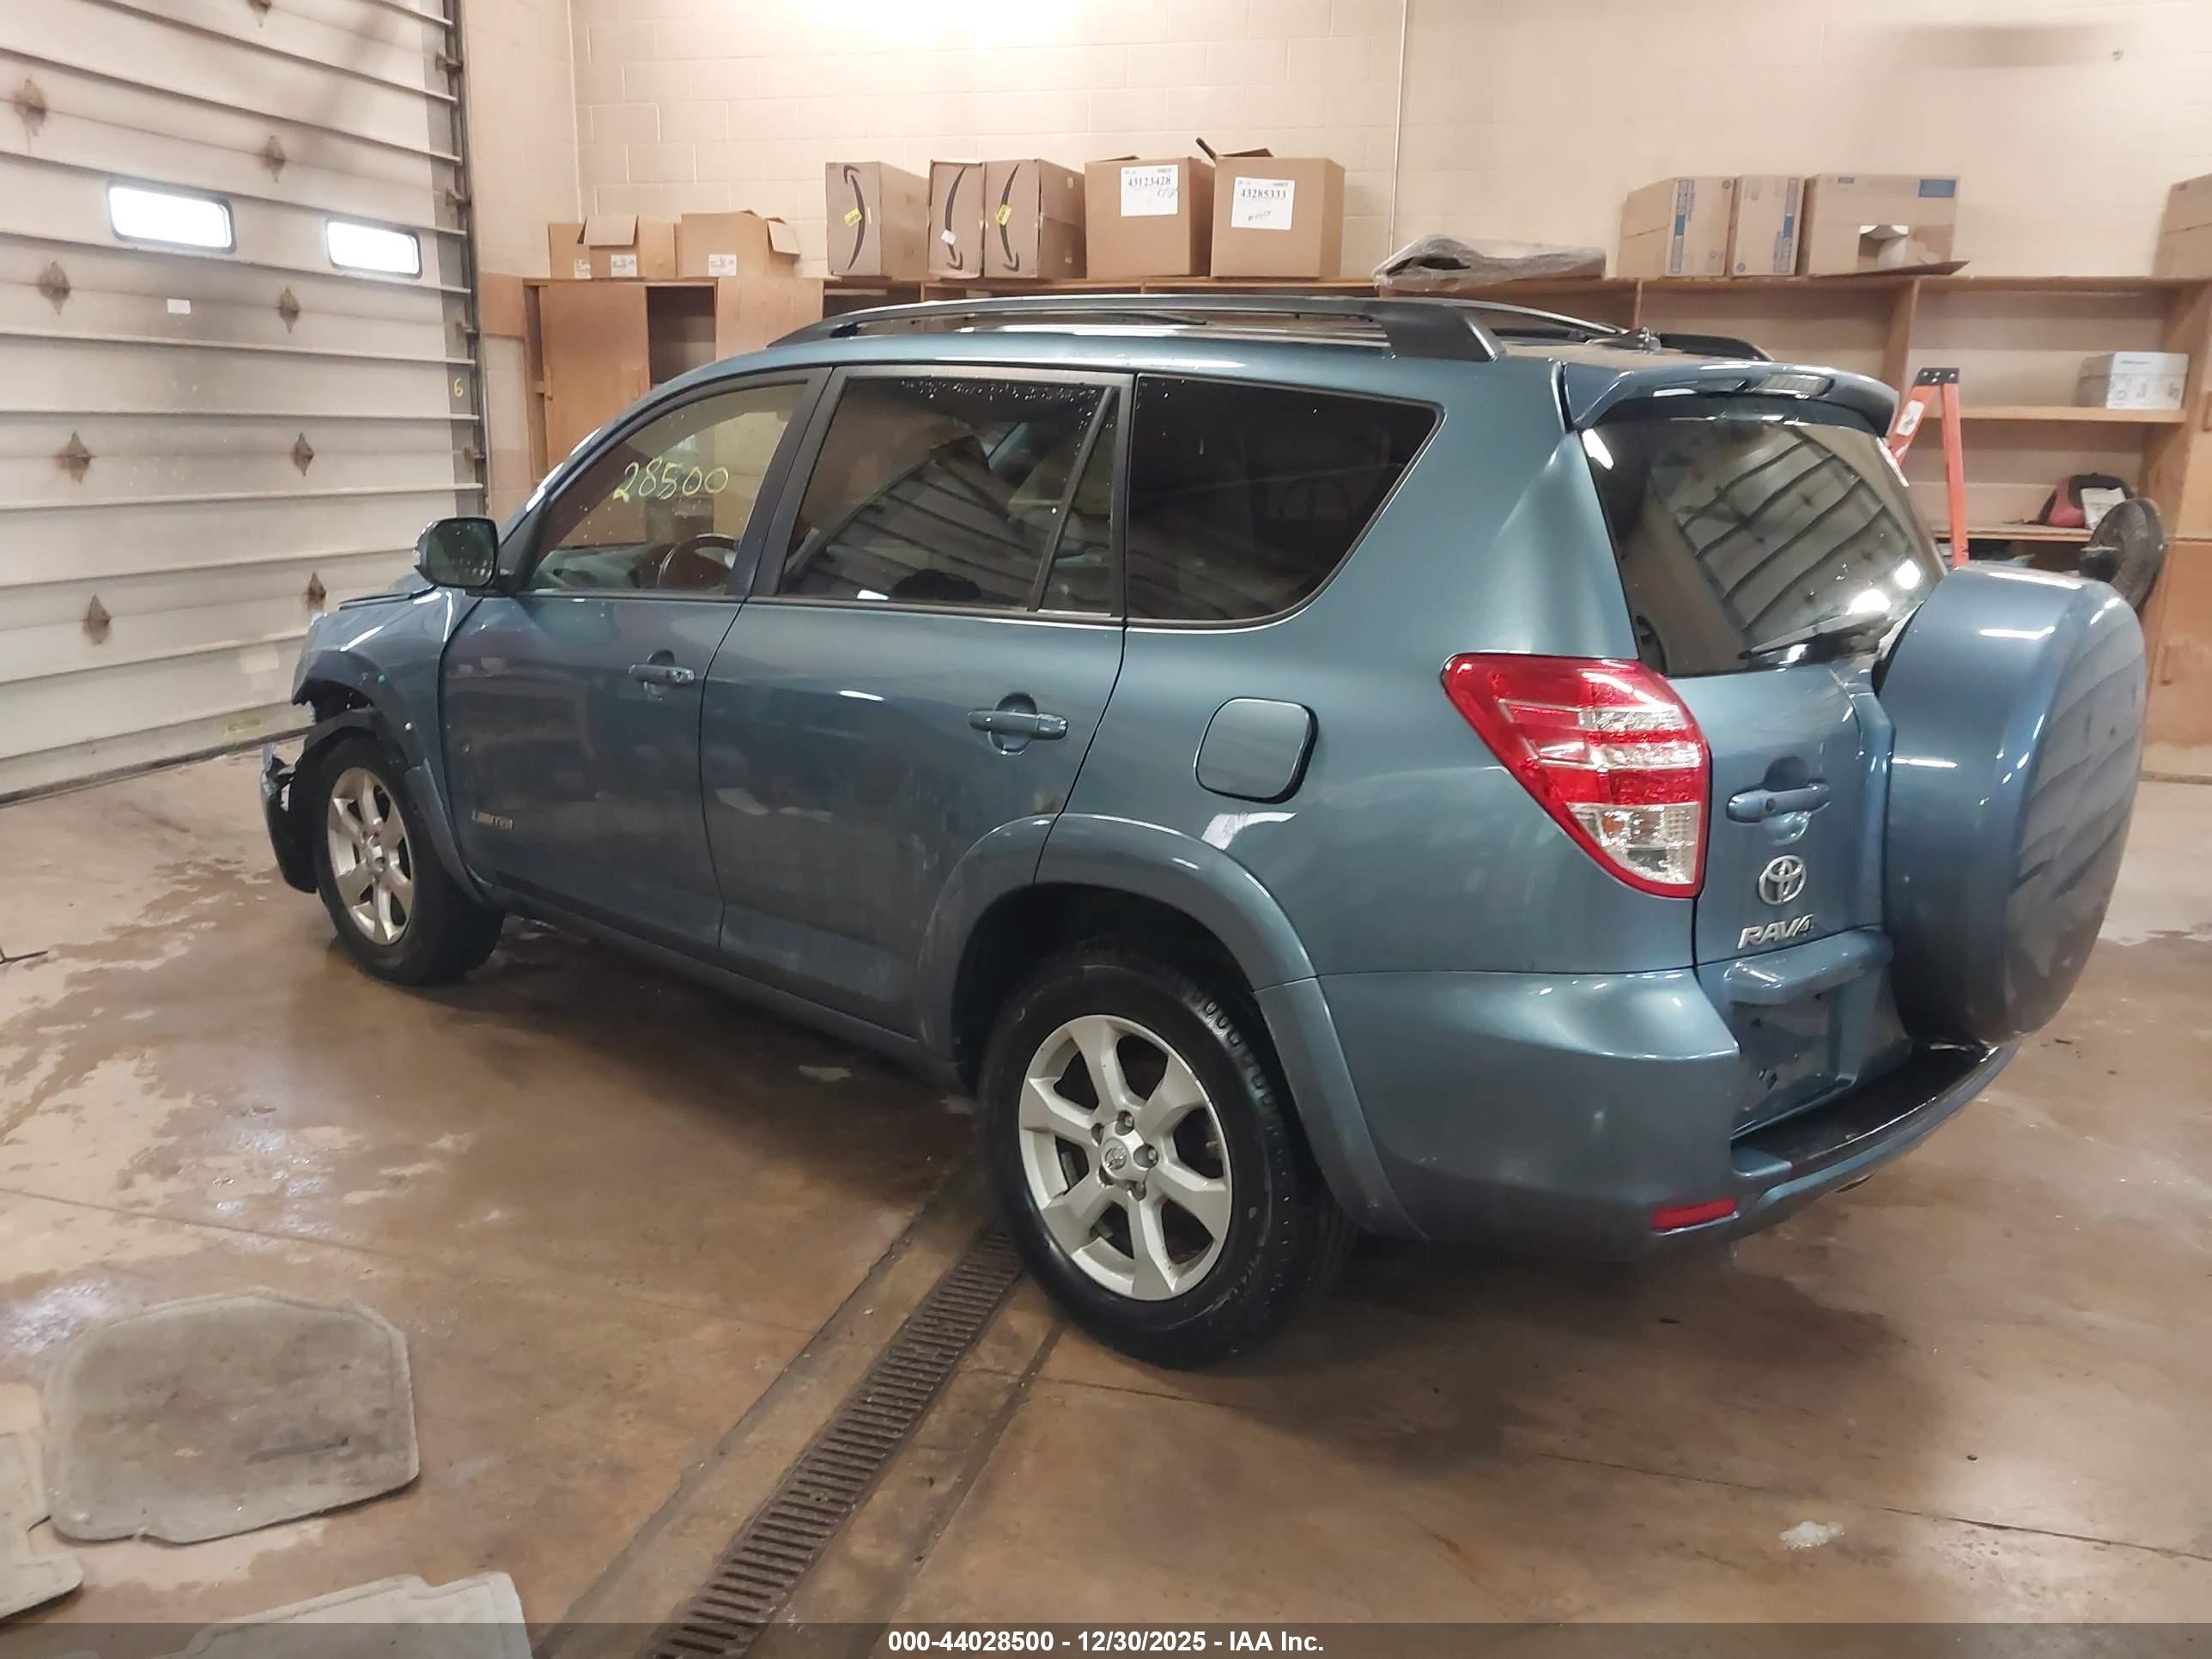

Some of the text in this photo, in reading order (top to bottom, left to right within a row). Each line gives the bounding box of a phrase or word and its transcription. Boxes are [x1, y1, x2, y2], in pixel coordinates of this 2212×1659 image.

[1127, 176, 1171, 186] 43123428
[1240, 187, 1287, 199] 43285333
[453, 377, 464, 398] 6
[612, 456, 729, 502] 28500
[1737, 914, 1814, 950] RAV4
